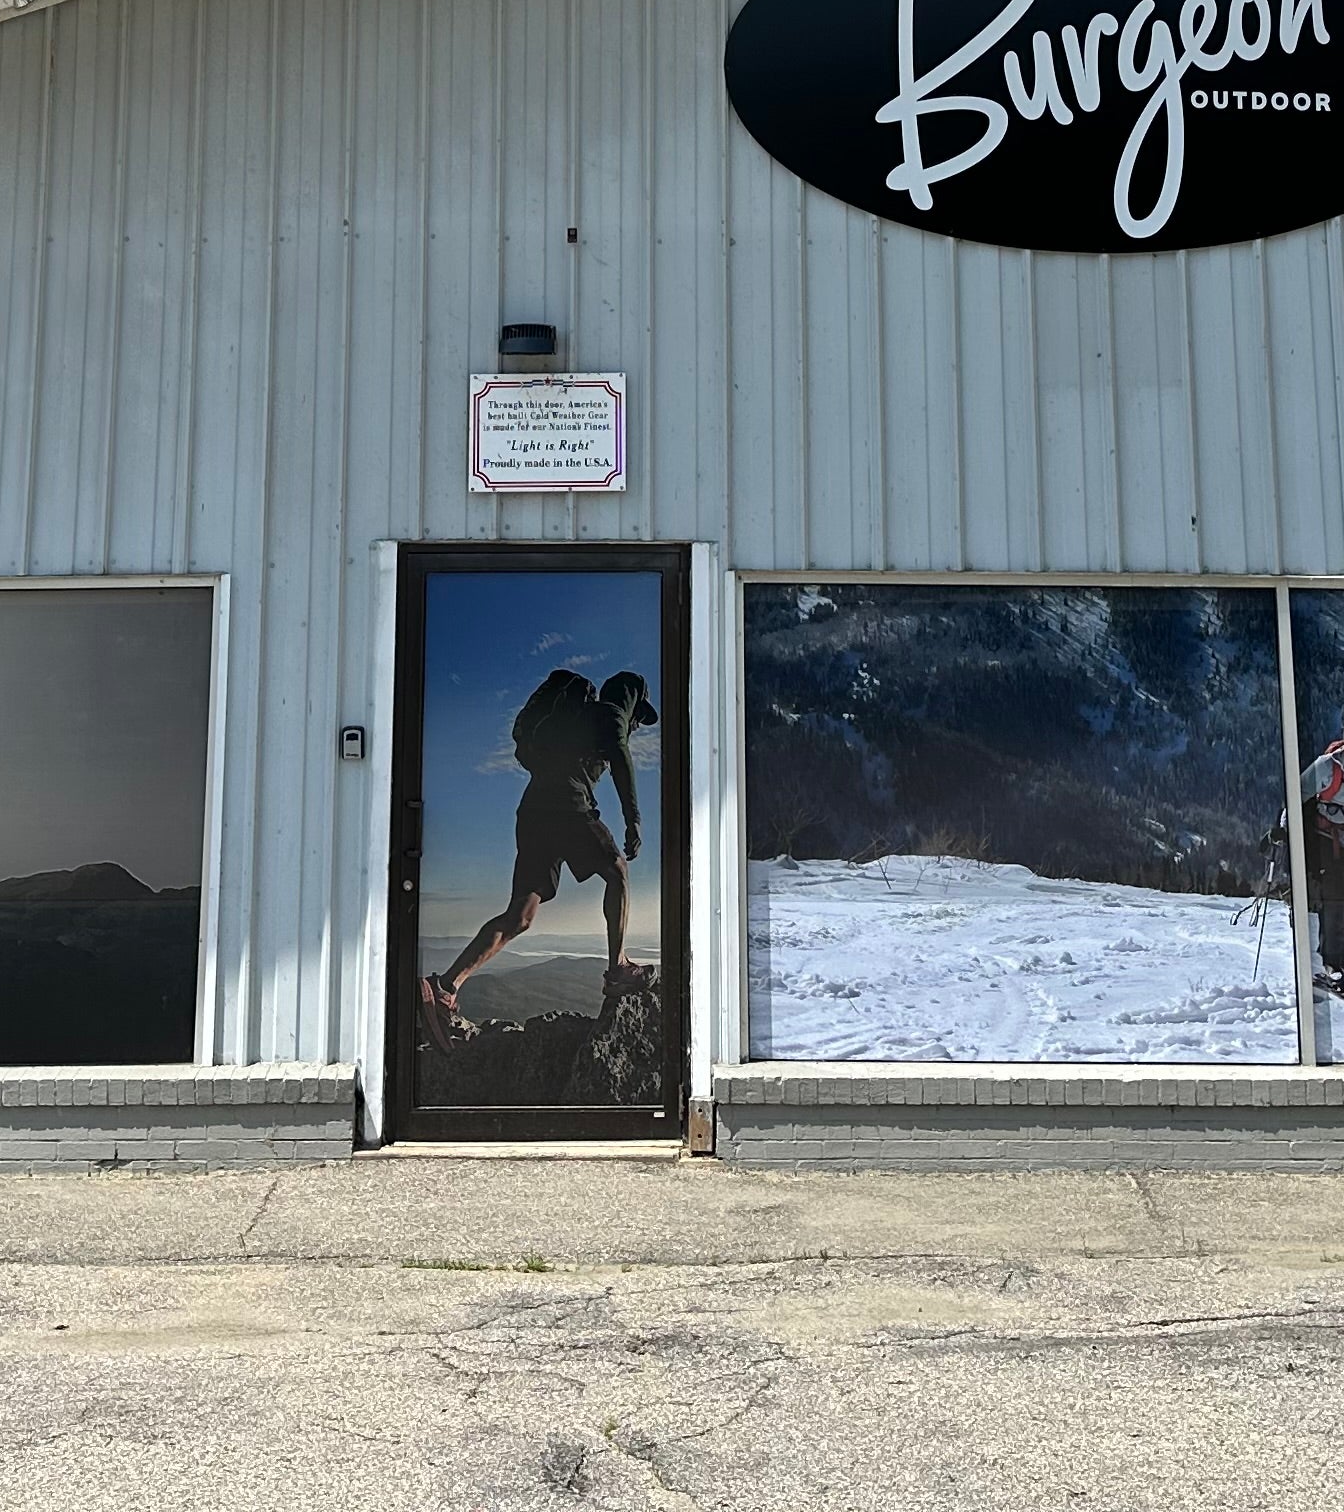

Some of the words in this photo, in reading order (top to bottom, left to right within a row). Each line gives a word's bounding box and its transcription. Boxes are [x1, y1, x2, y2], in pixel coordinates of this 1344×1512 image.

[1190, 90, 1331, 112] OUTDOOR
[488, 400, 523, 410] Through
[526, 400, 542, 408] this
[568, 400, 608, 408] America's
[488, 412, 504, 420] best
[530, 411, 549, 419] Cold
[552, 411, 586, 419] Weather
[588, 411, 608, 419] Gear
[483, 423, 491, 431] is
[492, 423, 515, 431] made
[517, 421, 529, 431] for
[507, 439, 541, 453] "Light
[545, 439, 555, 451] is
[558, 439, 595, 453] Right"
[483, 457, 522, 470] Proudly
[524, 457, 551, 468] made
[553, 457, 563, 468] in
[565, 457, 582, 468] the
[584, 457, 613, 468] U.S.A.
